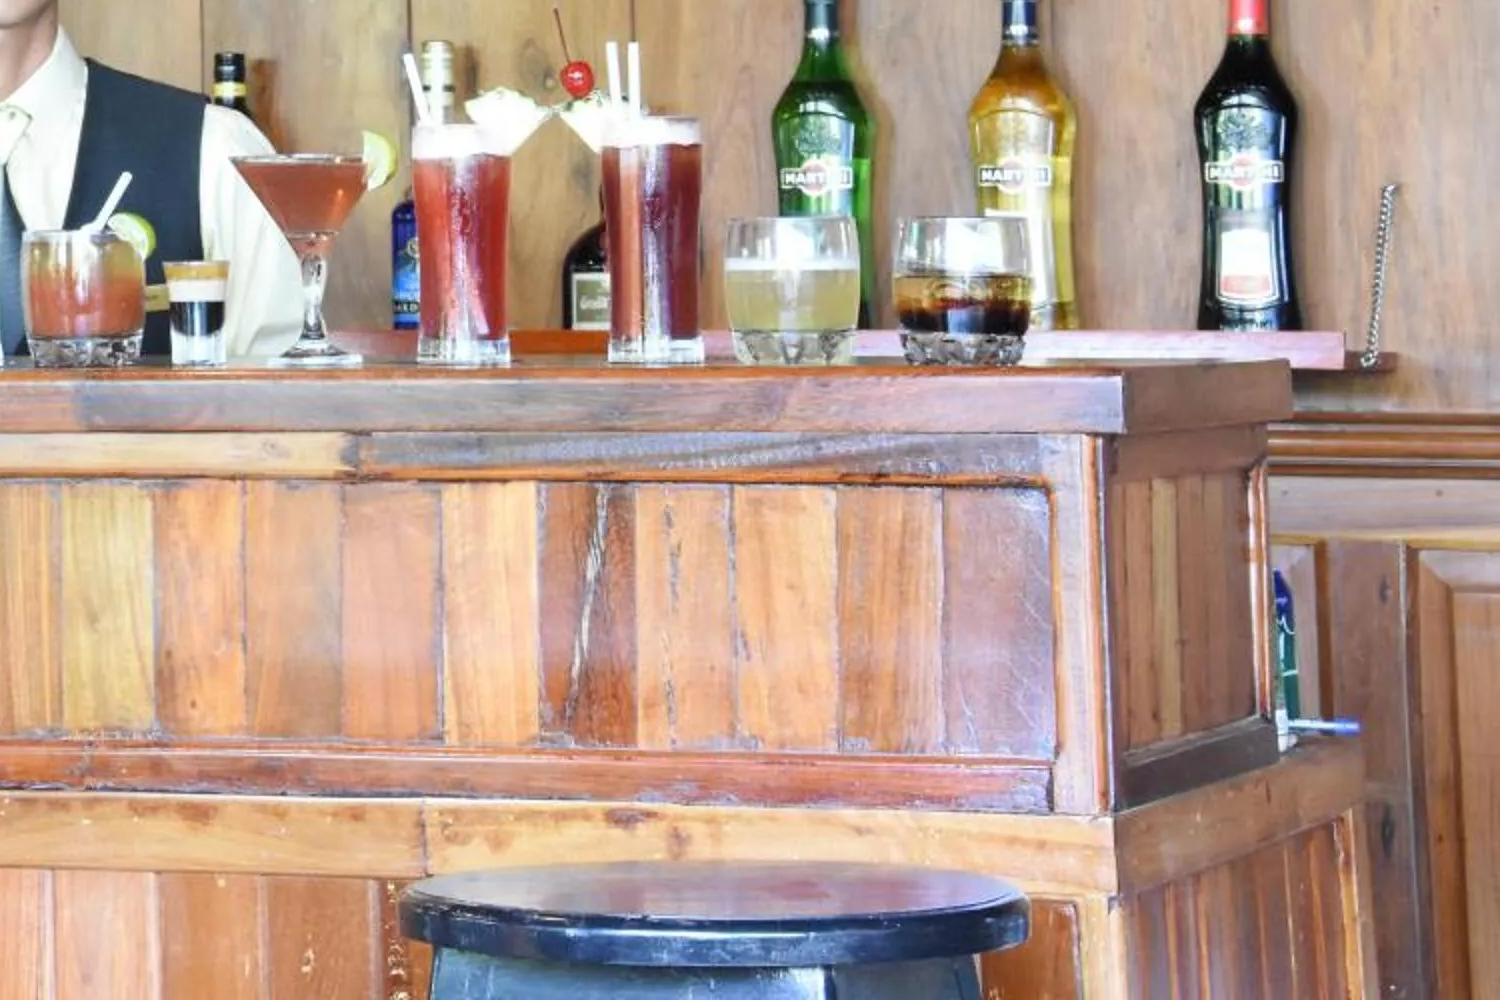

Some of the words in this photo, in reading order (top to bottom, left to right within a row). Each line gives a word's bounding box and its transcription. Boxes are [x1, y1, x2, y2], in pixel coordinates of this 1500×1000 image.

[785, 171, 848, 185] MARTI
[981, 169, 1045, 183] MARTI
[1210, 165, 1279, 178] MARTNI
